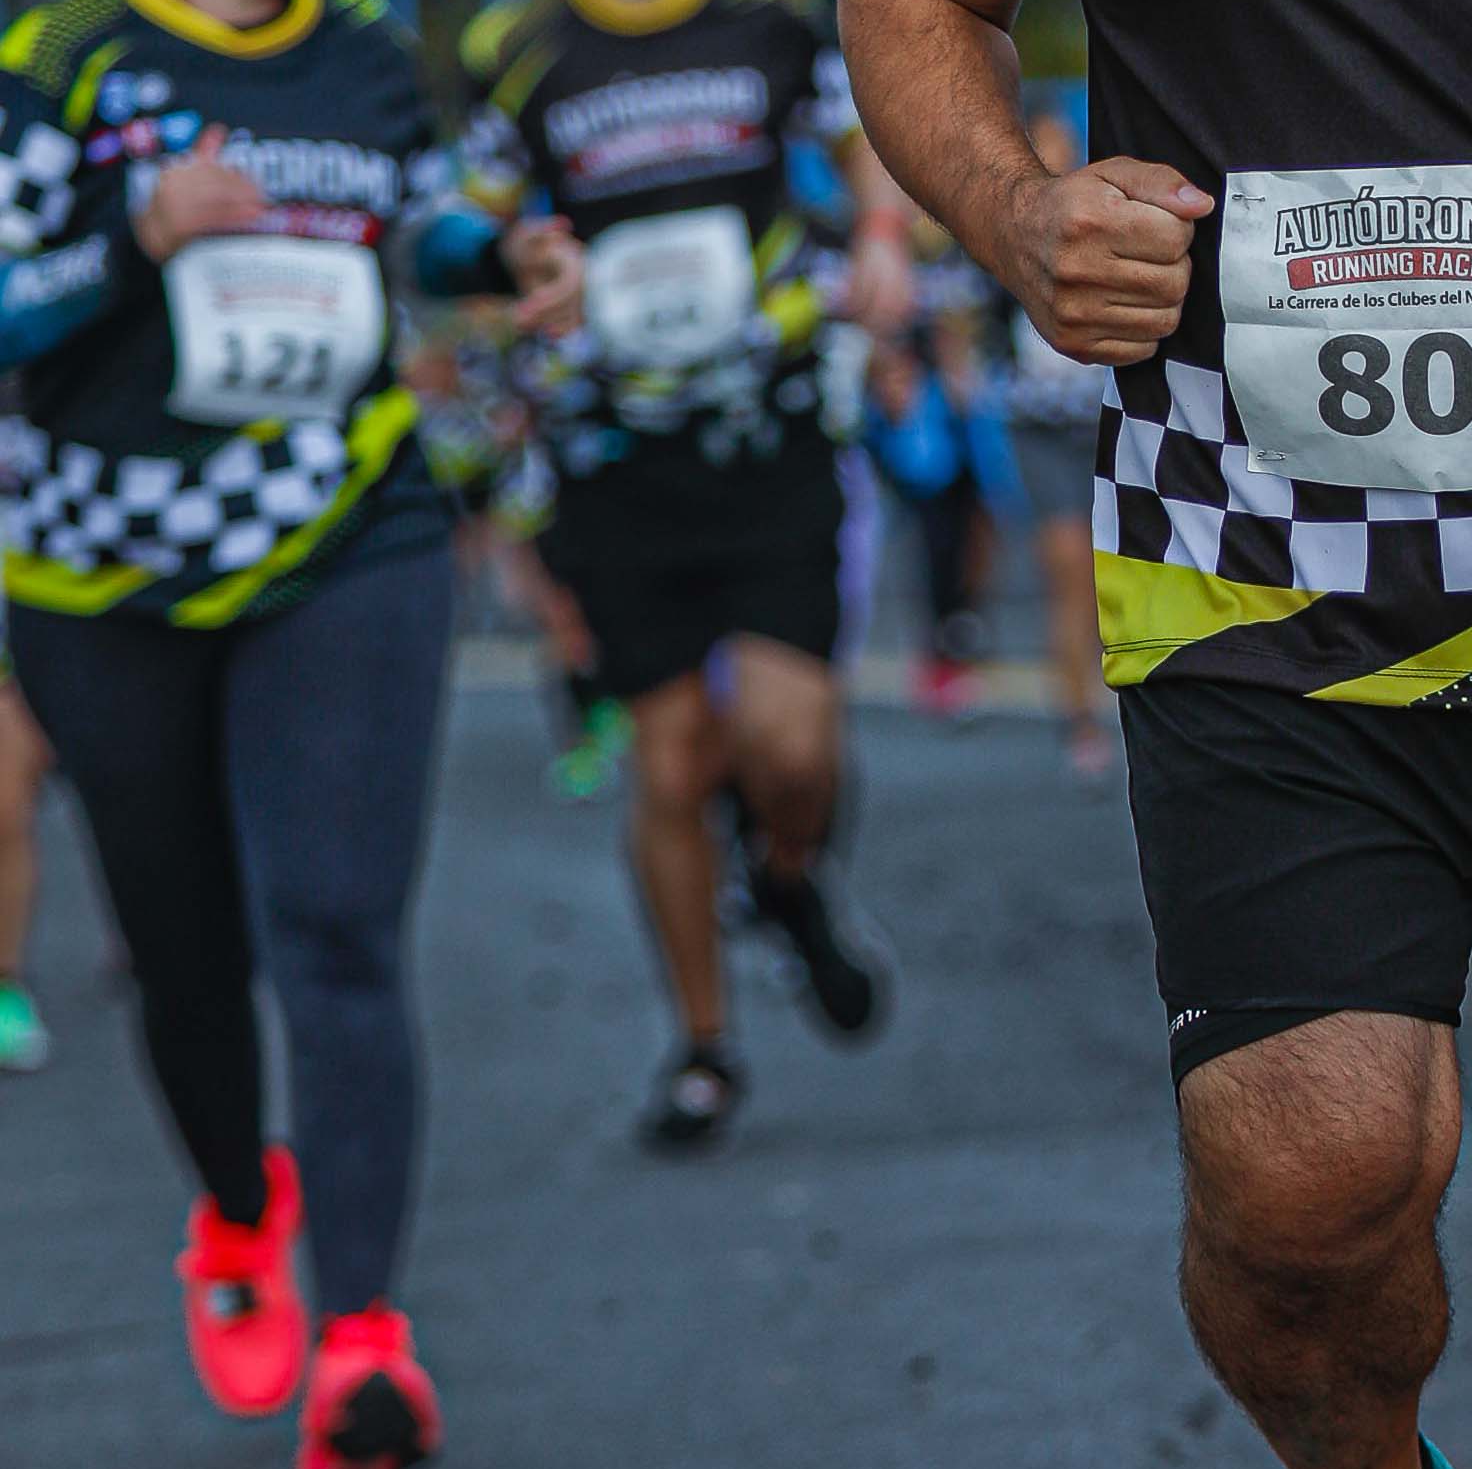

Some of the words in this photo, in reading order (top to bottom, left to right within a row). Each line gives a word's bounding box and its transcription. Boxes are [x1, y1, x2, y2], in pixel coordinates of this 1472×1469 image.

[1312, 252, 1414, 283] RUNNING
[1268, 295, 1284, 309] La
[1287, 293, 1339, 309] Carrera
[1342, 293, 1360, 308] de
[1364, 292, 1385, 307] los
[1388, 290, 1436, 307] Clubes
[1440, 289, 1462, 305] del
[218, 331, 334, 395] 121
